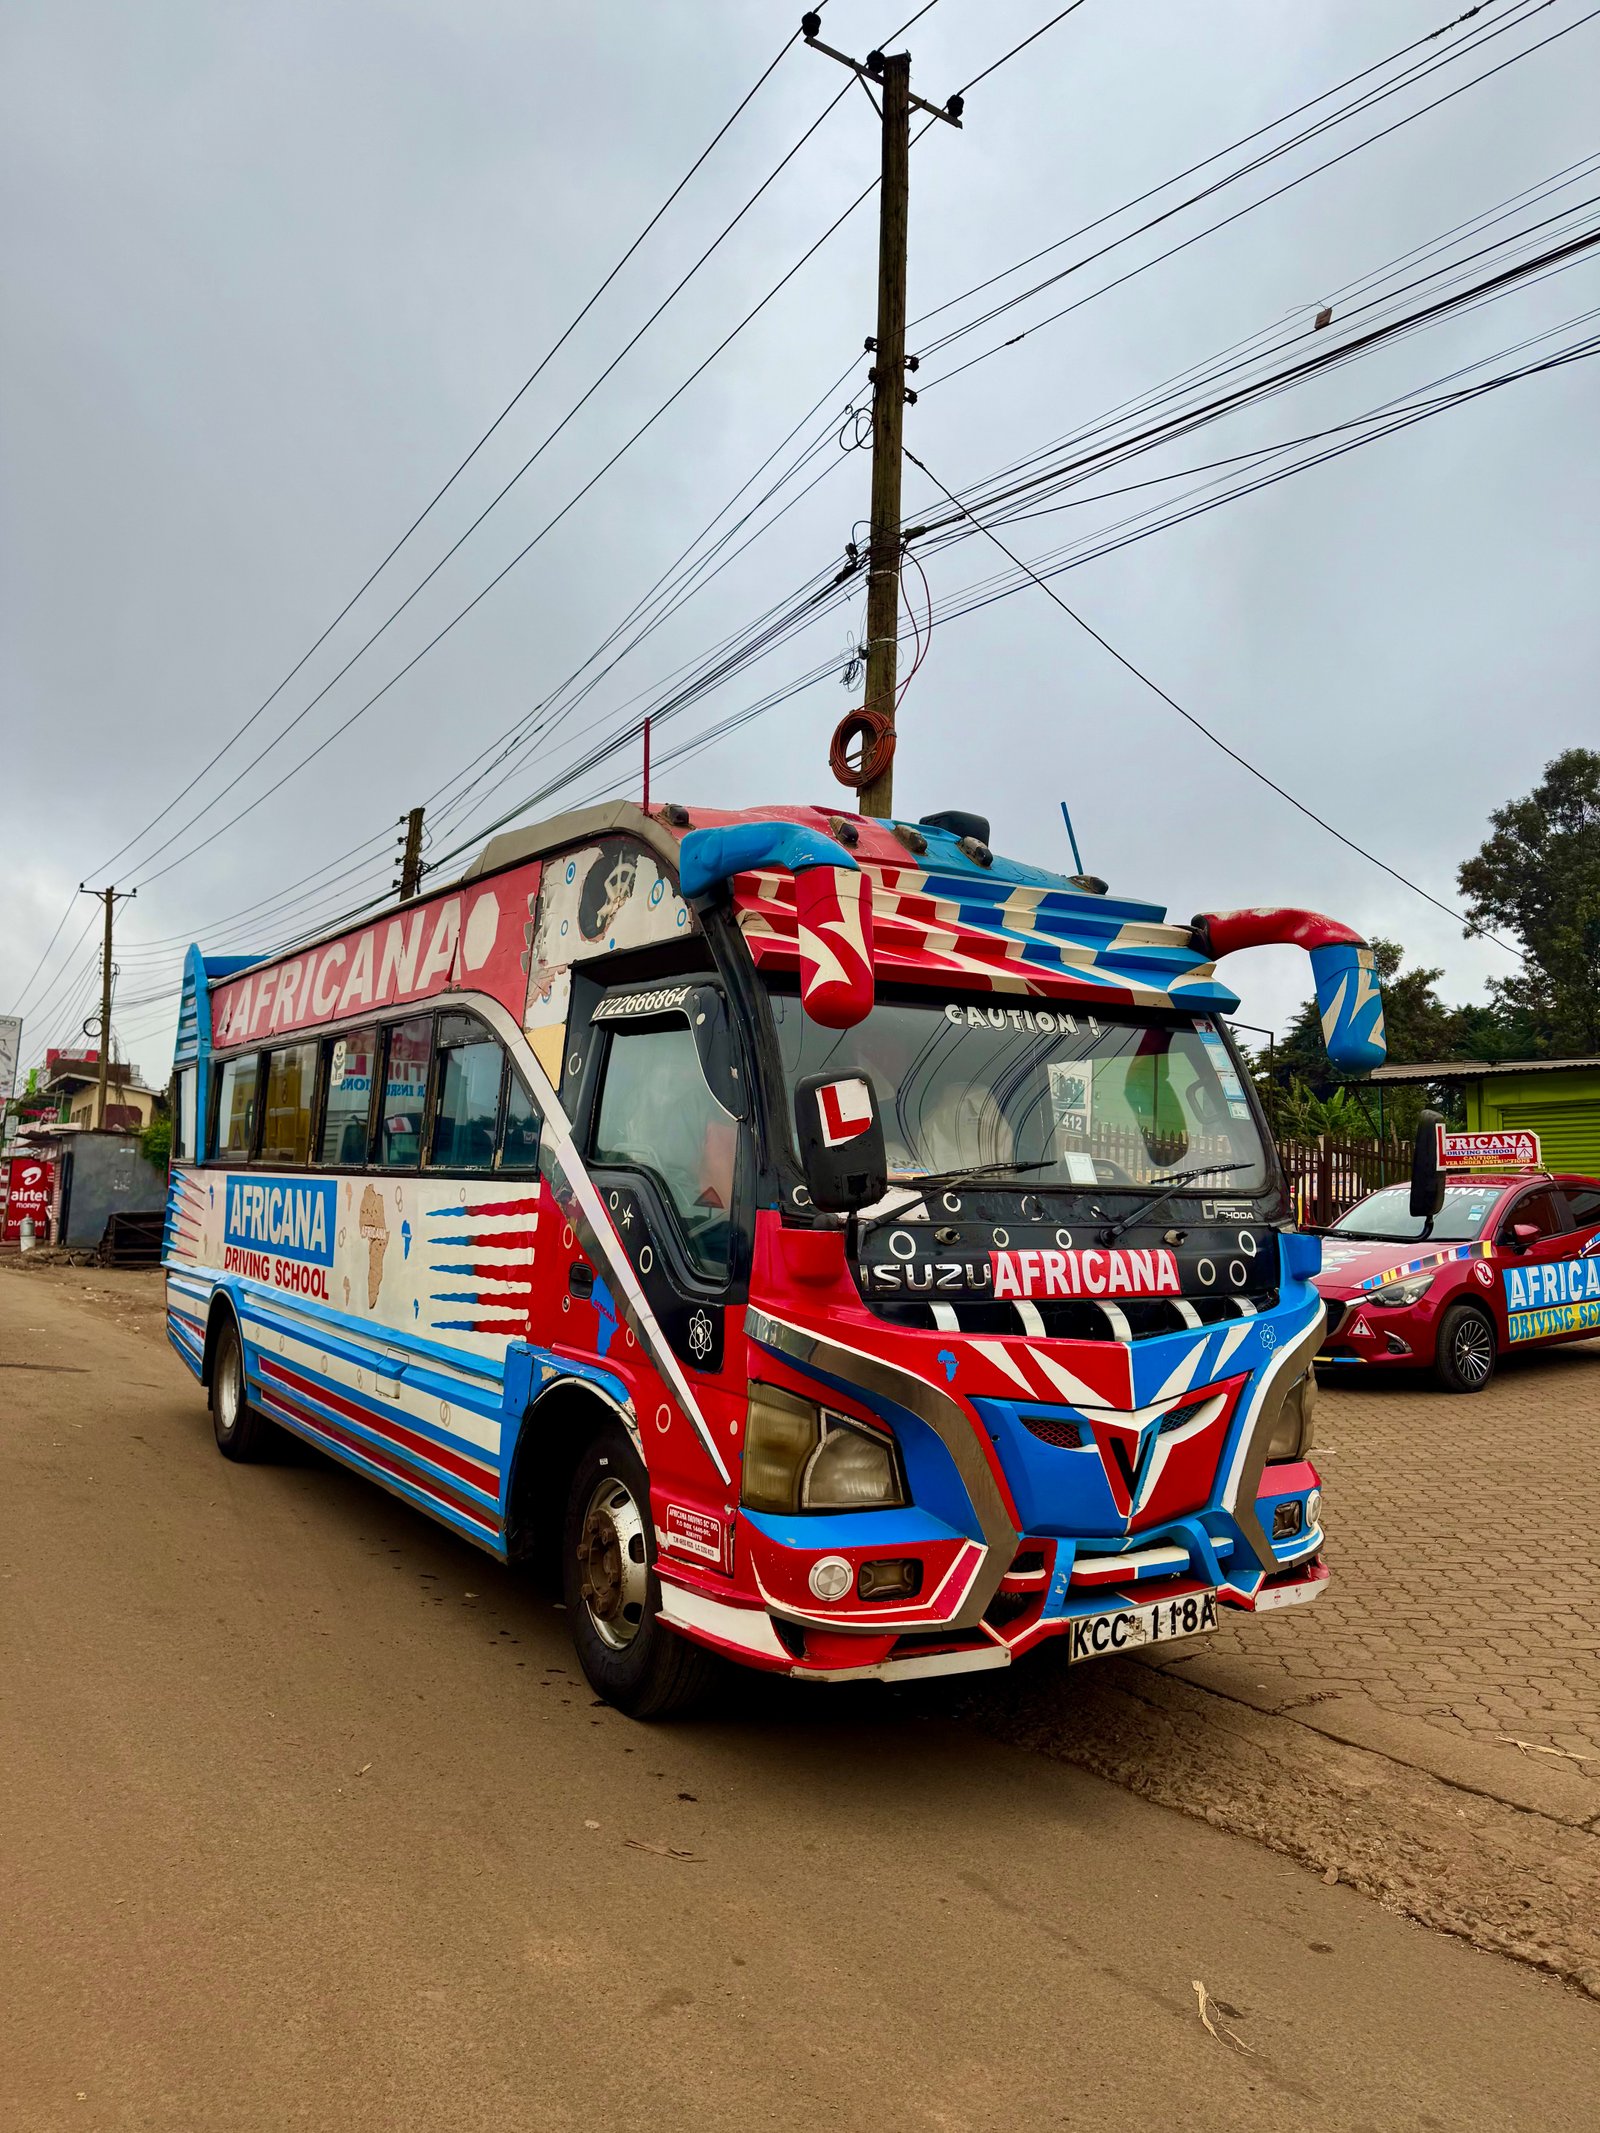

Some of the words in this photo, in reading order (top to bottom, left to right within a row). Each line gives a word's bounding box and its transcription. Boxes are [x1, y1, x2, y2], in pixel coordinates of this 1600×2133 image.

[228, 897, 462, 1040] AFRICANA
[592, 986, 692, 1019] 0722666864
[945, 1004, 1080, 1035] CAUTION
[820, 1085, 871, 1140] L
[1062, 1113, 1082, 1131] 412
[11, 1188, 48, 1202] airtel
[16, 1202, 41, 1212] money
[230, 1184, 327, 1253] AFRICANA
[224, 1246, 270, 1281] DRIVING
[275, 1259, 329, 1301] SCHOOL
[859, 1263, 991, 1292] ISUZU
[994, 1249, 1179, 1297] AFRICANA
[1510, 1258, 1600, 1309] AFRICA
[1509, 1307, 1576, 1342] DRIVING
[1073, 1613, 1129, 1659] KCC
[1151, 1593, 1217, 1641] 118A
